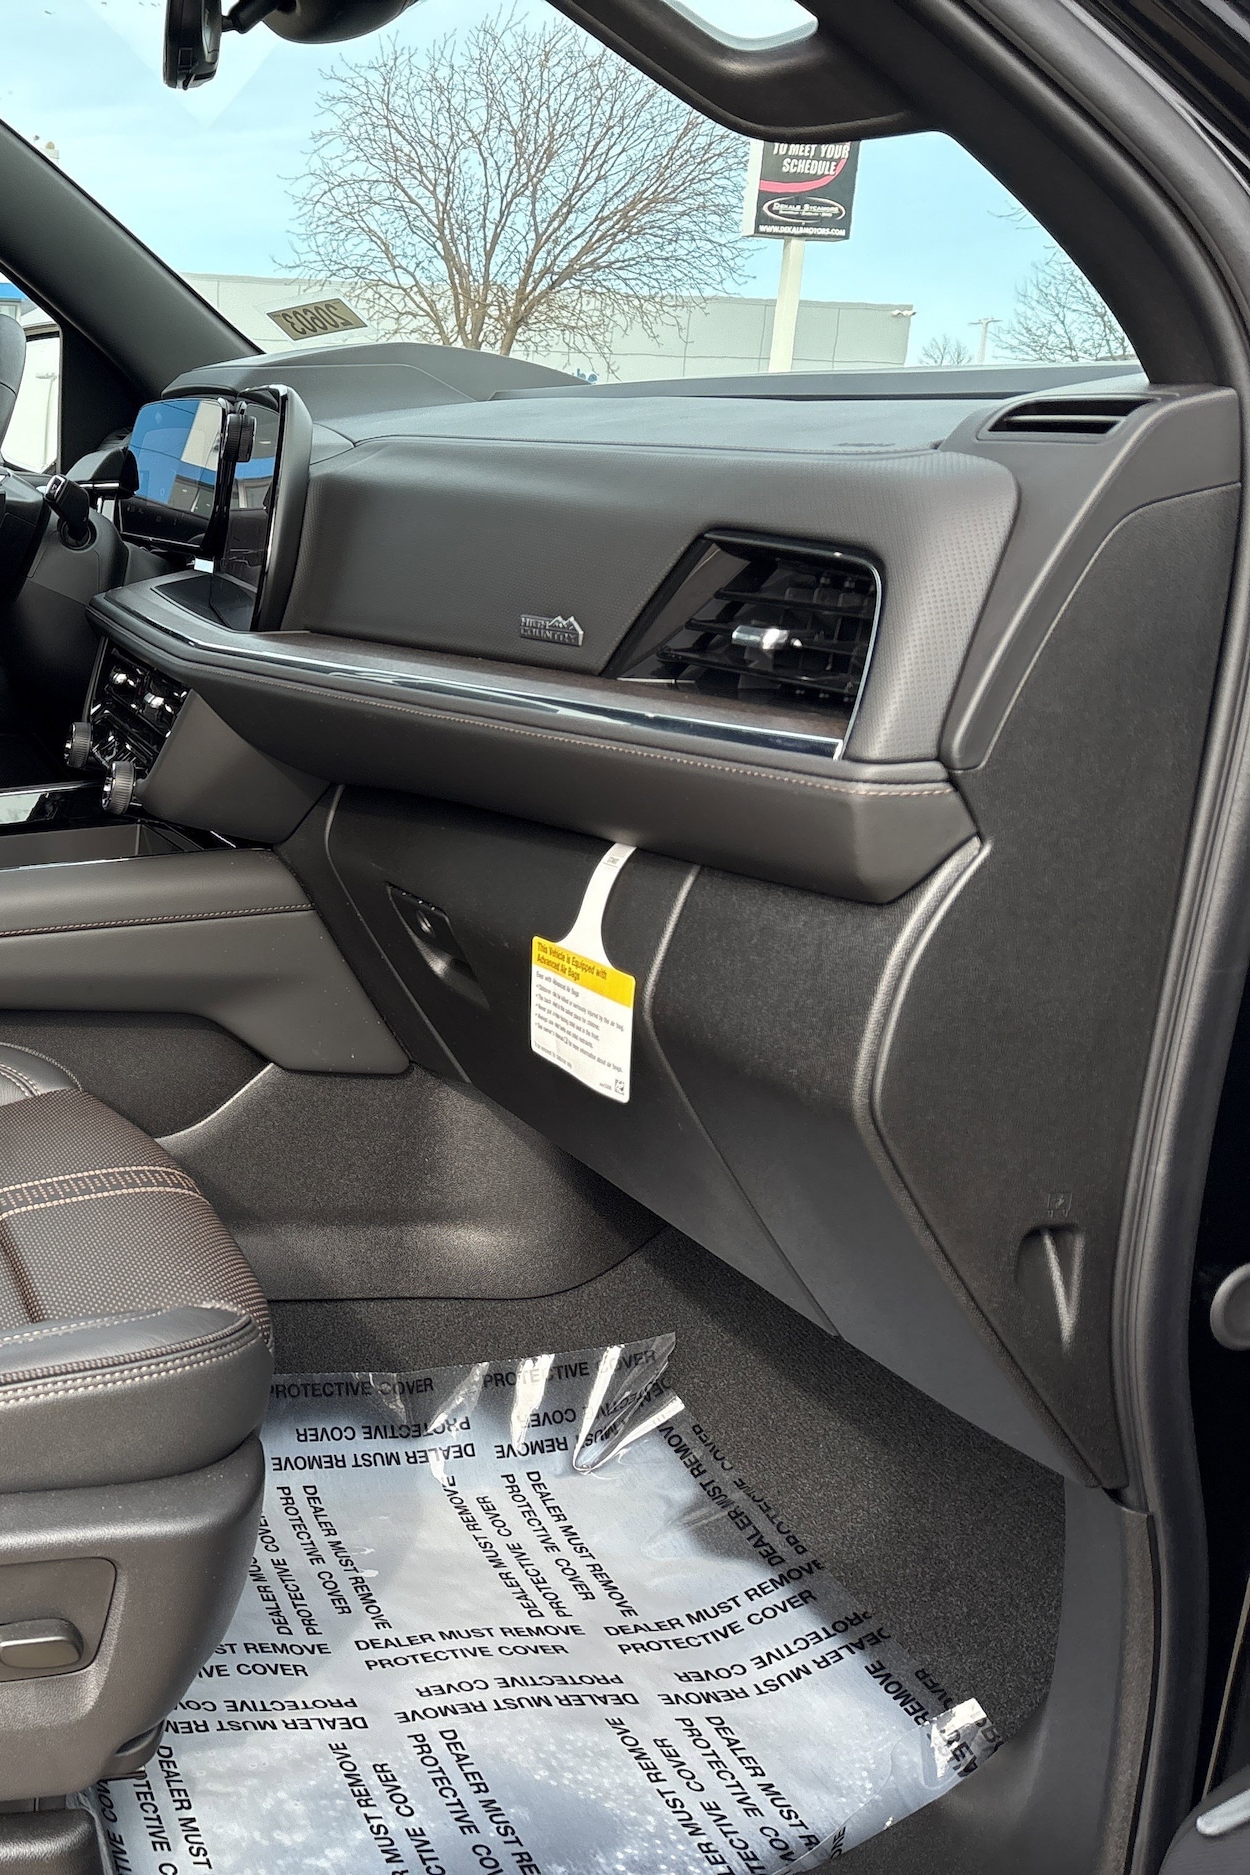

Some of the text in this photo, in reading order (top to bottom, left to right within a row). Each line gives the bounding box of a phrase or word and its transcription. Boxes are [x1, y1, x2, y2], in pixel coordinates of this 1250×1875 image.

[773, 143, 850, 159] TO MEET YOUR
[782, 158, 837, 175] SCHEDULE
[295, 1426, 356, 1443] COVER
[351, 1452, 401, 1468] MUST
[494, 1436, 568, 1459] REMOVE
[271, 1453, 347, 1471] REMOVE
[277, 1486, 352, 1615] PROTECTIVE COVER
[302, 1484, 393, 1630] DEALER MUST REMOVE
[443, 1475, 545, 1619] DEALER MUST REMOVE
[476, 1495, 573, 1618] PROTECTIVE COVER
[501, 1473, 596, 1601] PROTECTIVE COVER
[526, 1471, 639, 1618] DEALER MUST REMOVE
[728, 1505, 786, 1567] DEALER
[258, 1513, 323, 1636] PROTECTIVE COVE
[603, 1559, 825, 1637] DEALER MUST REMOVE
[257, 1585, 293, 1636] DEALER
[617, 1589, 817, 1656] PROTECTIVE COVER
[214, 1642, 332, 1655] ST REMOVE
[354, 1624, 586, 1651] DEALER MUST REMOVE
[364, 1644, 569, 1671] PROTECTIVE COVER
[236, 1663, 309, 1677] COVER
[415, 1673, 624, 1698] PROTECTIVE COVER
[674, 1663, 748, 1683] COVER
[752, 1663, 813, 1696] MUST
[864, 1660, 933, 1728] REMOVE
[174, 1697, 358, 1712] PROTECTIVE COV
[394, 1692, 640, 1724] DEALER MUST REMOVE
[658, 1687, 750, 1706] REMOVE
[216, 1719, 278, 1731] MUST
[282, 1717, 369, 1730] DEALER
[604, 1717, 668, 1784] REMOVE
[653, 1737, 705, 1793] COVER
[705, 1715, 810, 1832] DEALER MUST
[96, 1778, 118, 1823] COV
[156, 1745, 213, 1870] DEALER MUST
[328, 1742, 404, 1864] MUST REMOVE
[372, 1762, 415, 1818] COVER
[407, 1733, 481, 1836] PROTECTIVE
[439, 1728, 490, 1794] DEALER
[479, 1798, 524, 1848] MUST
[675, 1717, 798, 1863] PROTECTIVE COV
[133, 1777, 172, 1852] TECTIVE
[656, 1788, 707, 1837] MUST
[405, 1827, 446, 1875] CTIVE
